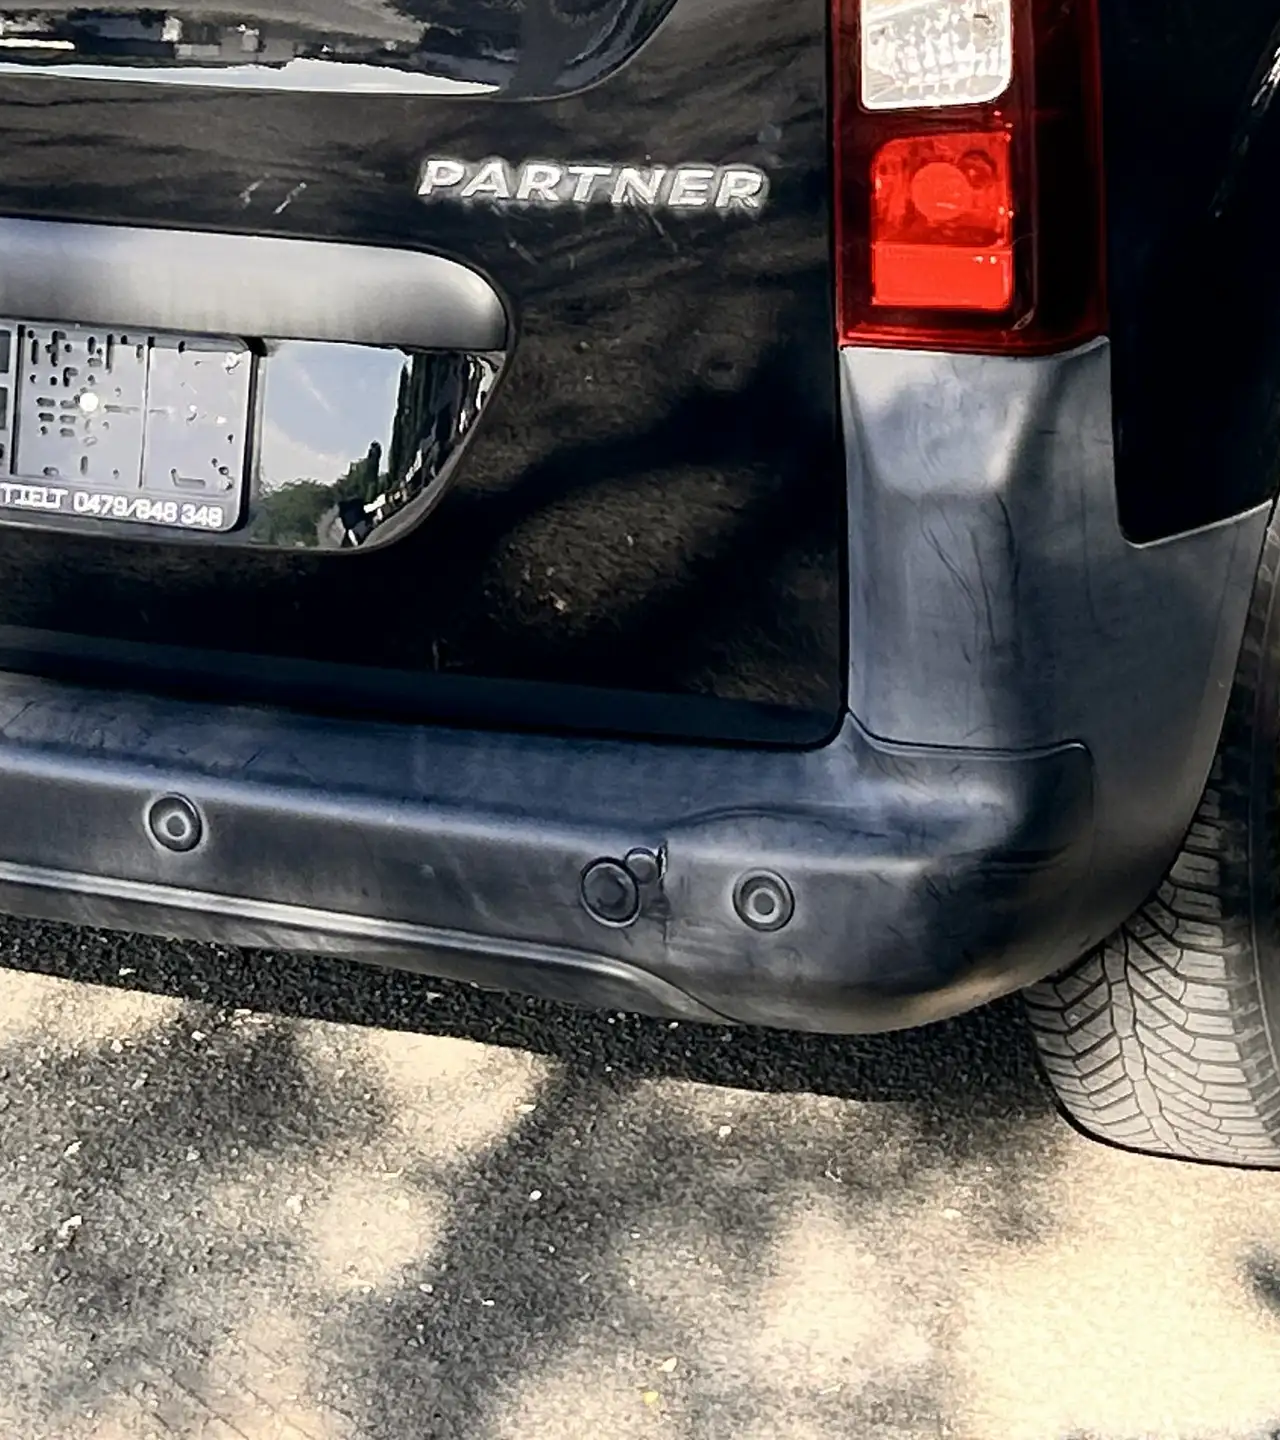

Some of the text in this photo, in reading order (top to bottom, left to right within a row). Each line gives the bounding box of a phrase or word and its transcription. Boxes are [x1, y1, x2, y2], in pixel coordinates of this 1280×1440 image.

[418, 159, 766, 208] PARTNER
[0, 482, 69, 510] TIELT
[181, 504, 223, 528] 348
